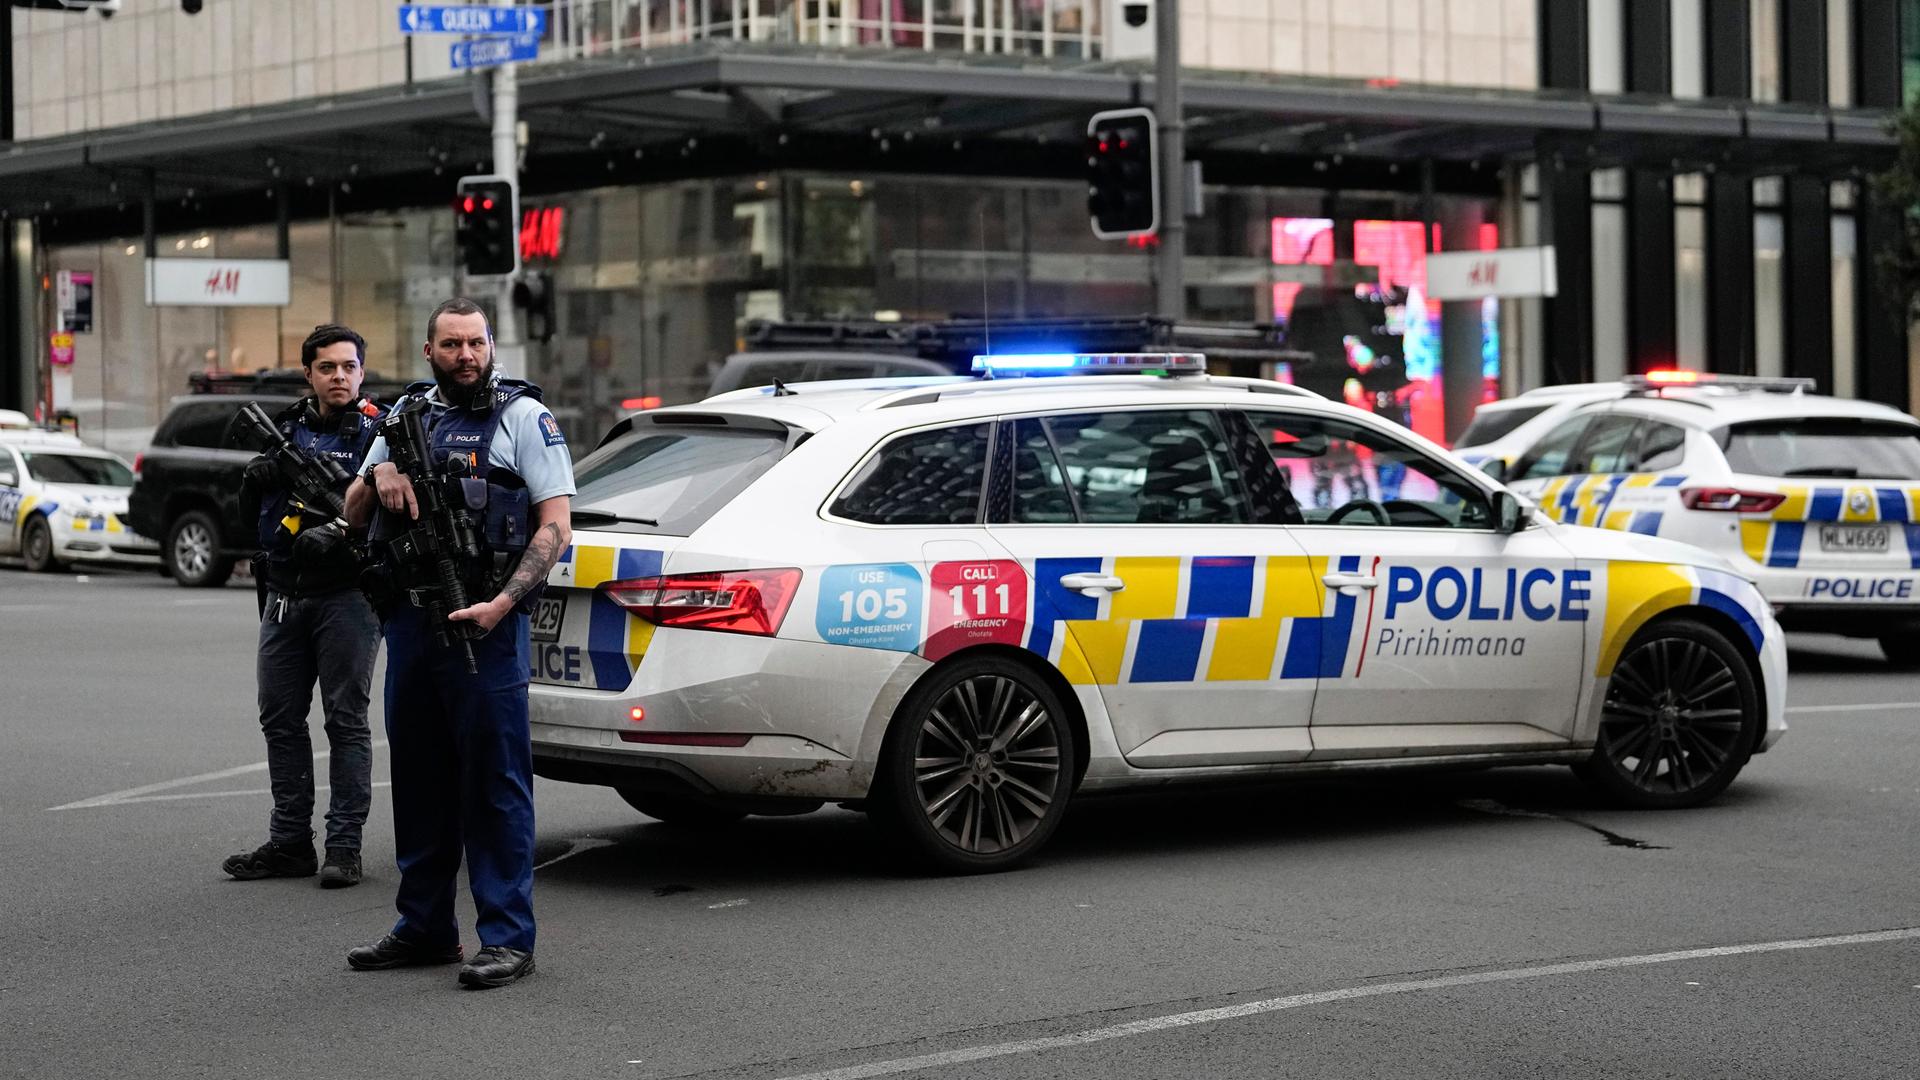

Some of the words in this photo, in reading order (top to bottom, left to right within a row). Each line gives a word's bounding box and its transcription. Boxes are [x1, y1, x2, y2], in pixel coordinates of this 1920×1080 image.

[441, 8, 492, 32] QUEEN
[455, 435, 480, 443] POLICE
[858, 571, 884, 584] USE
[963, 568, 996, 581] CALL
[1384, 566, 1592, 621] POLICE
[1810, 578, 1914, 598] POLICE
[839, 588, 908, 623] 105
[949, 584, 1010, 617] 111
[828, 623, 912, 636] NON-EMERGENCY
[953, 618, 1007, 628] EMERGENCY
[967, 630, 993, 638] Ohotata
[1375, 627, 1526, 656] Pirihimana
